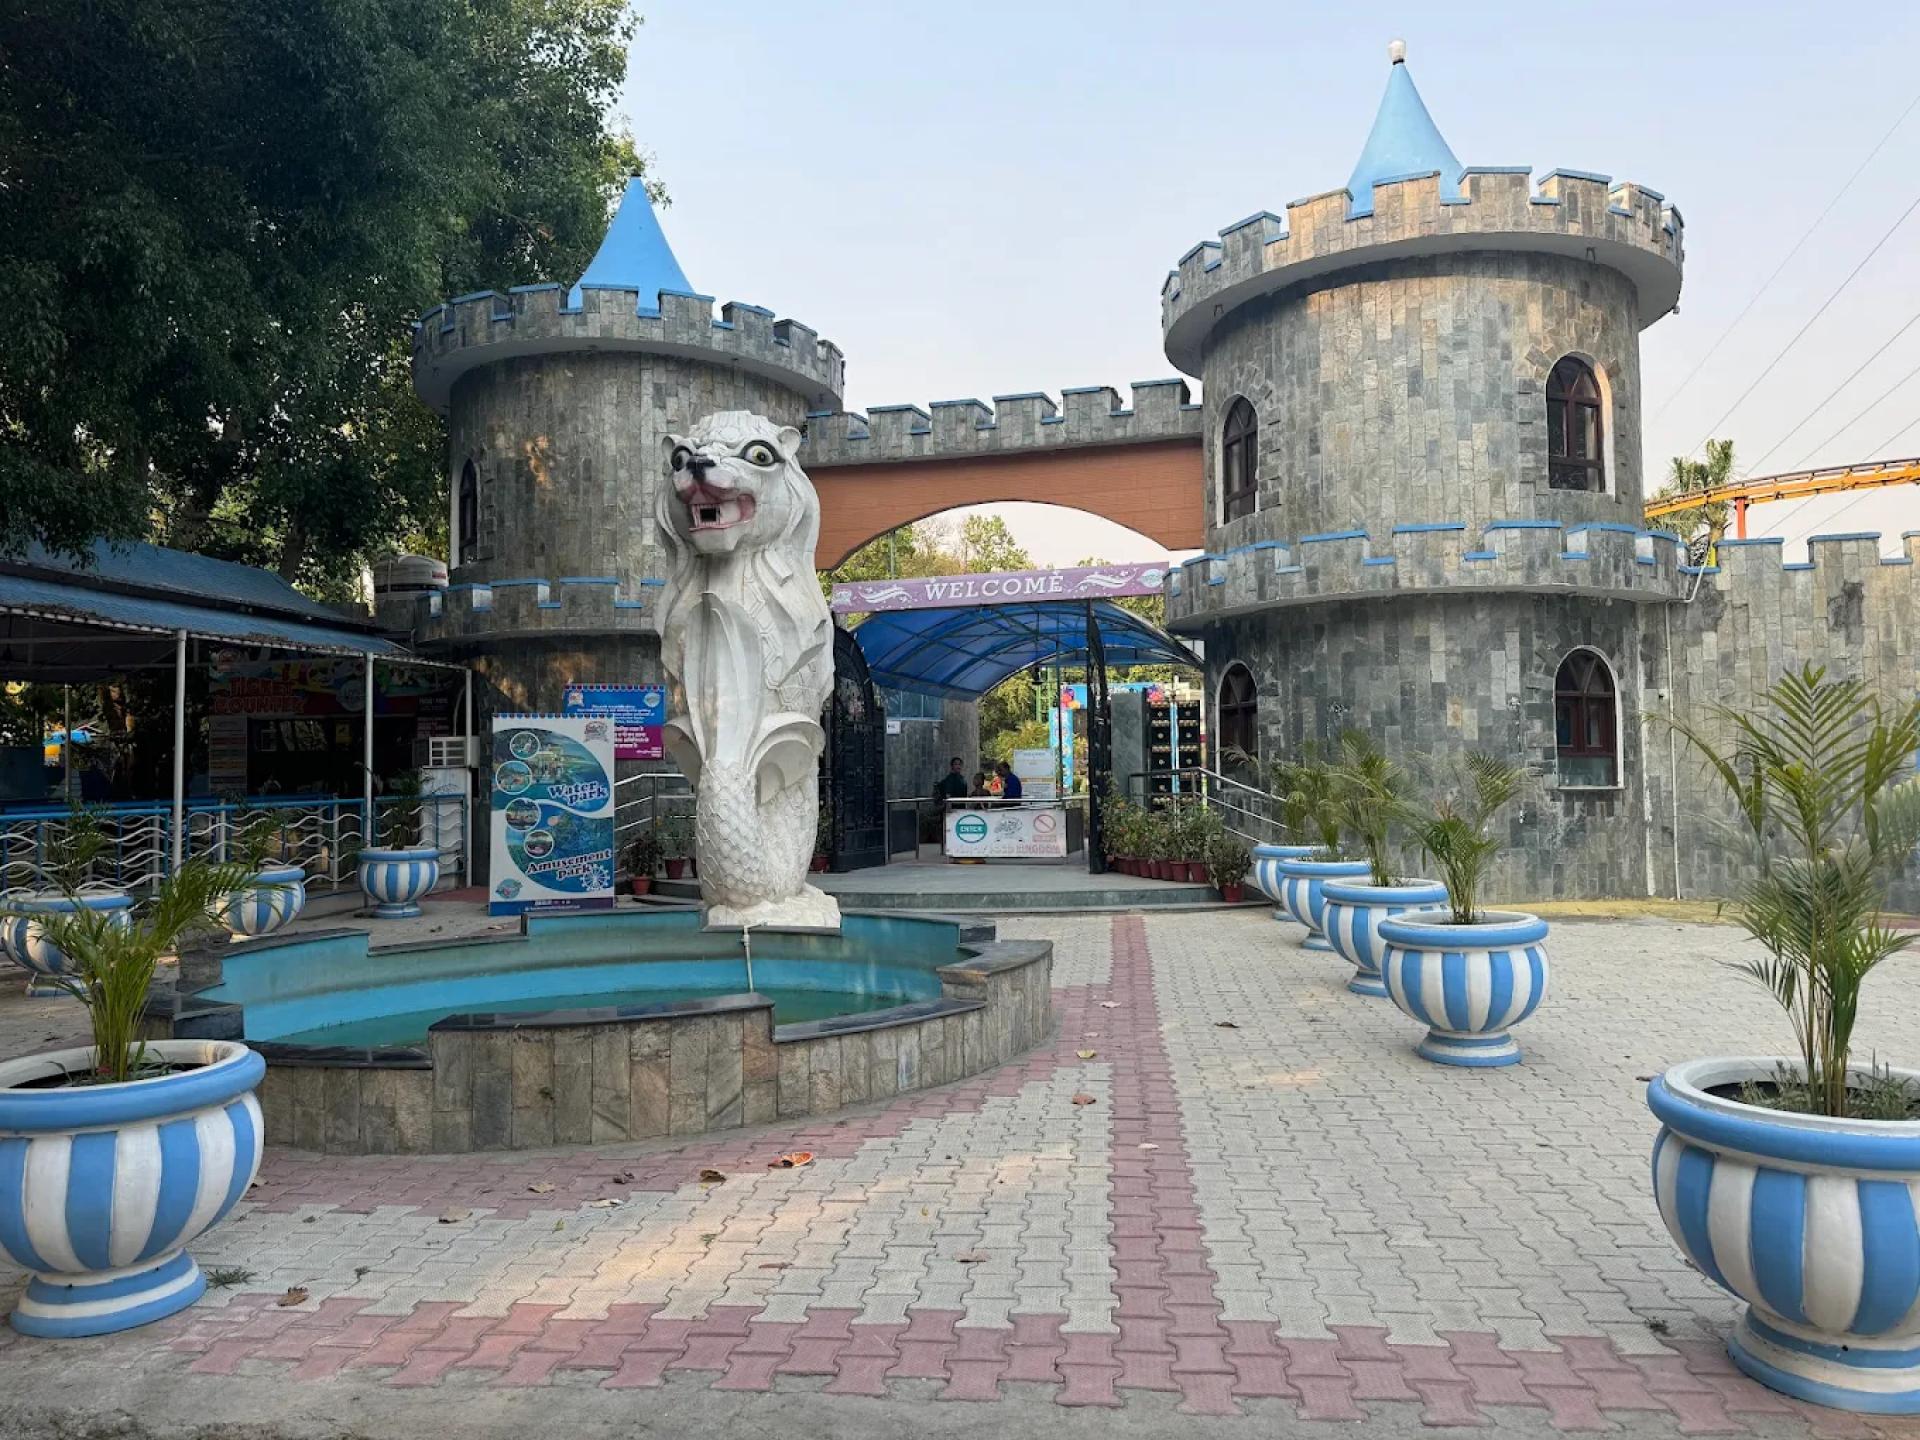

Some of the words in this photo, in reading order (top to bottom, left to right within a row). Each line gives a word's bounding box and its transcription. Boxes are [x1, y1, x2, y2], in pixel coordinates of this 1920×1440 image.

[925, 576, 1064, 600] WELCOME
[548, 781, 598, 798] Water
[960, 825, 983, 833] ENTER
[527, 849, 611, 873] Amusement
